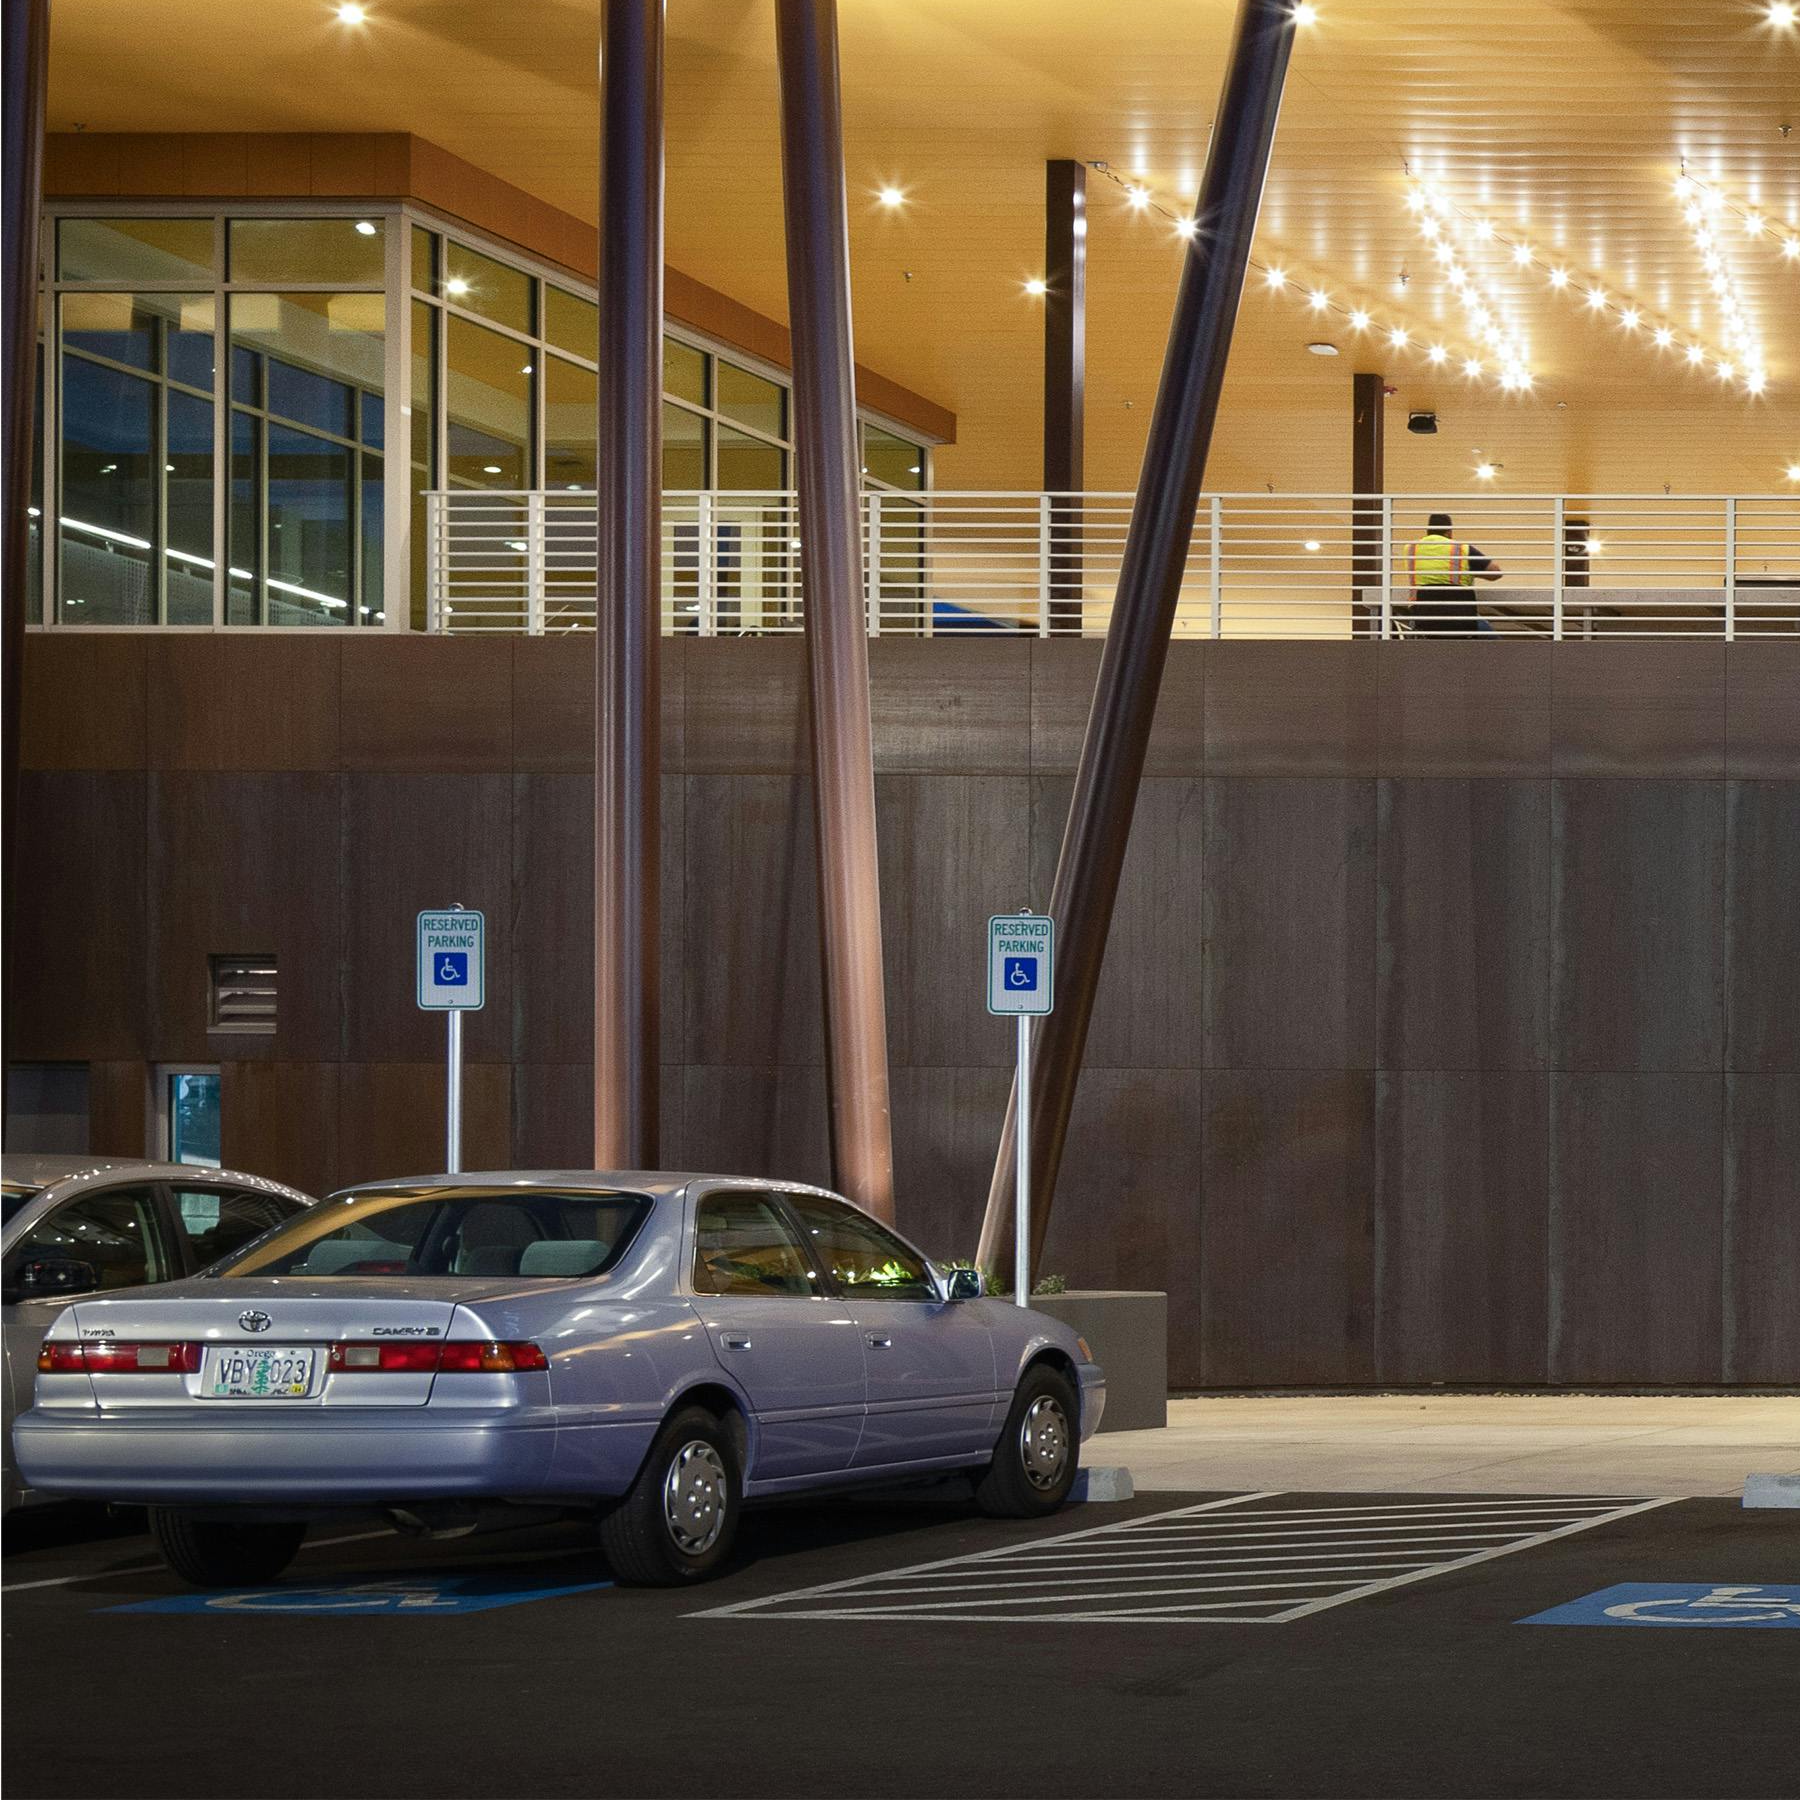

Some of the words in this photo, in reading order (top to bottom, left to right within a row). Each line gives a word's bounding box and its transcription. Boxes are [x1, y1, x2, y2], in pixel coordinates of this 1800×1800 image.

[423, 918, 478, 931] RESERVED
[994, 923, 1049, 936] RESERVED
[427, 935, 475, 948] PARKING
[998, 940, 1045, 953] PARKING
[247, 1349, 281, 1359] Orego
[220, 1358, 258, 1384] VBY
[269, 1359, 306, 1384] 023
